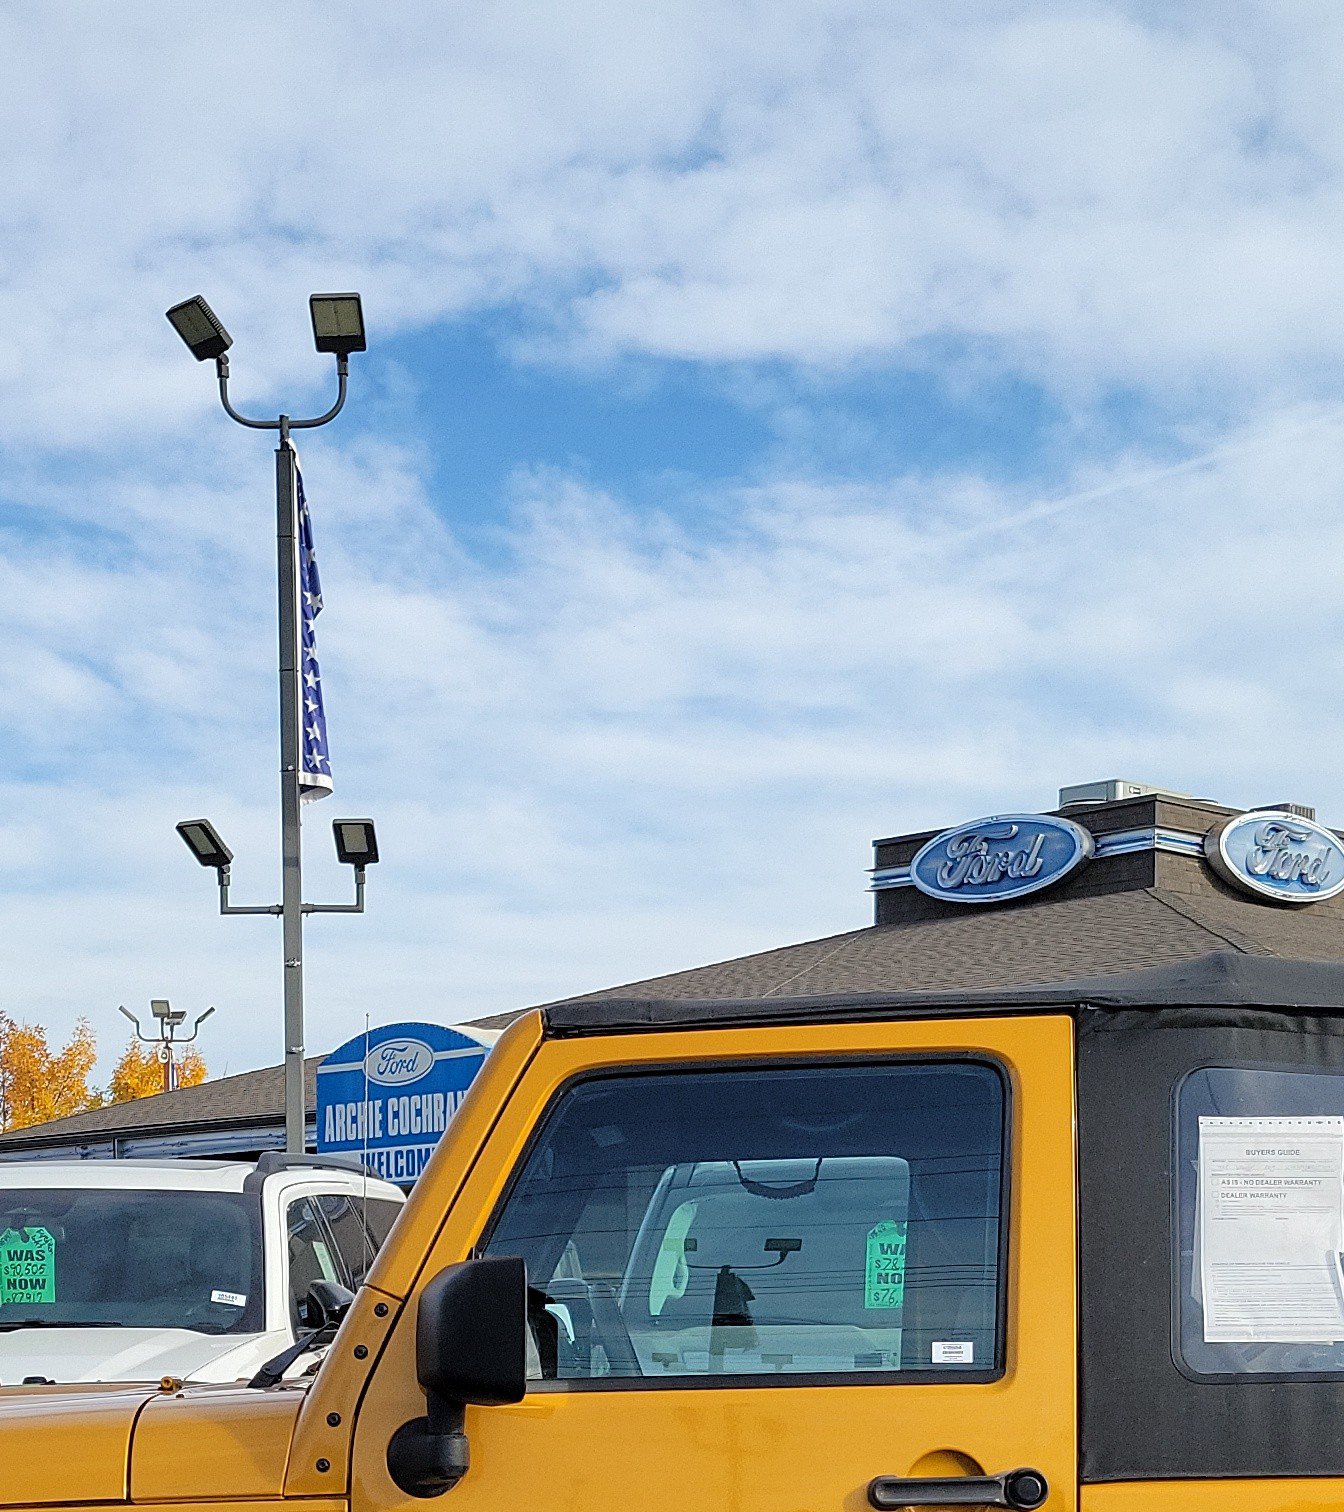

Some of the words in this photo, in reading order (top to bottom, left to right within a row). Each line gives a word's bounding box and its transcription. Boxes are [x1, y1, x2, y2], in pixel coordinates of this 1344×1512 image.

[937, 824, 1043, 889] Ford
[1246, 822, 1332, 887] Ford
[377, 1045, 419, 1076] Ford
[324, 1099, 383, 1142] ARCHIE
[387, 1089, 469, 1137] COCHRA
[360, 1147, 435, 1178] WELCOM
[7, 1249, 45, 1261] WAS
[7, 1278, 46, 1290] NOW
[876, 1272, 903, 1284] NO
[873, 1288, 899, 1305] $76,
